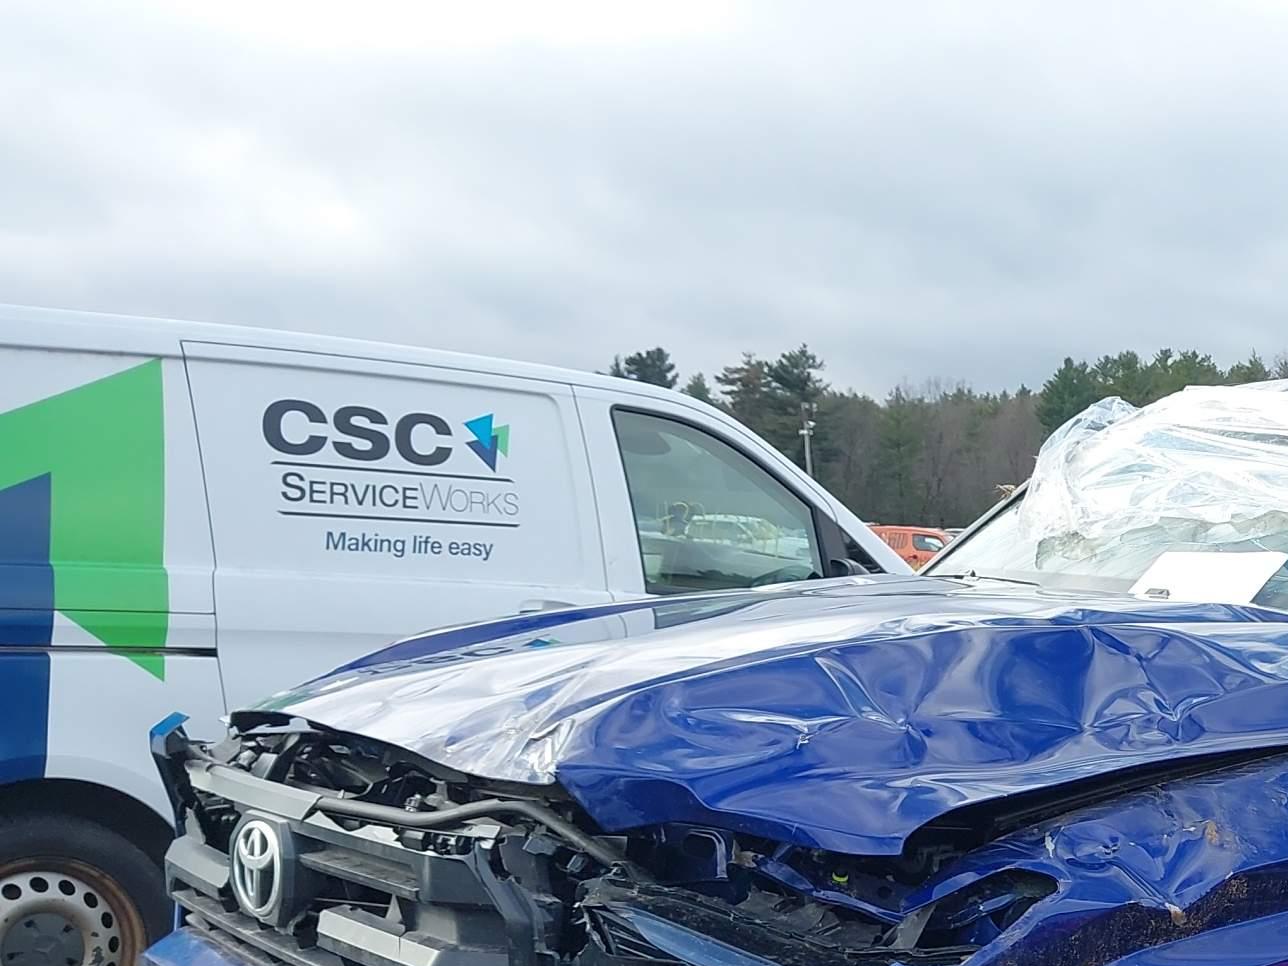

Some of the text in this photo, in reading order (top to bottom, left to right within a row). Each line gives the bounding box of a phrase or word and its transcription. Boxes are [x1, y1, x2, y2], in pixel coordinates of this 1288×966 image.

[262, 399, 453, 466] CSC
[325, 530, 494, 560] Making life easy
